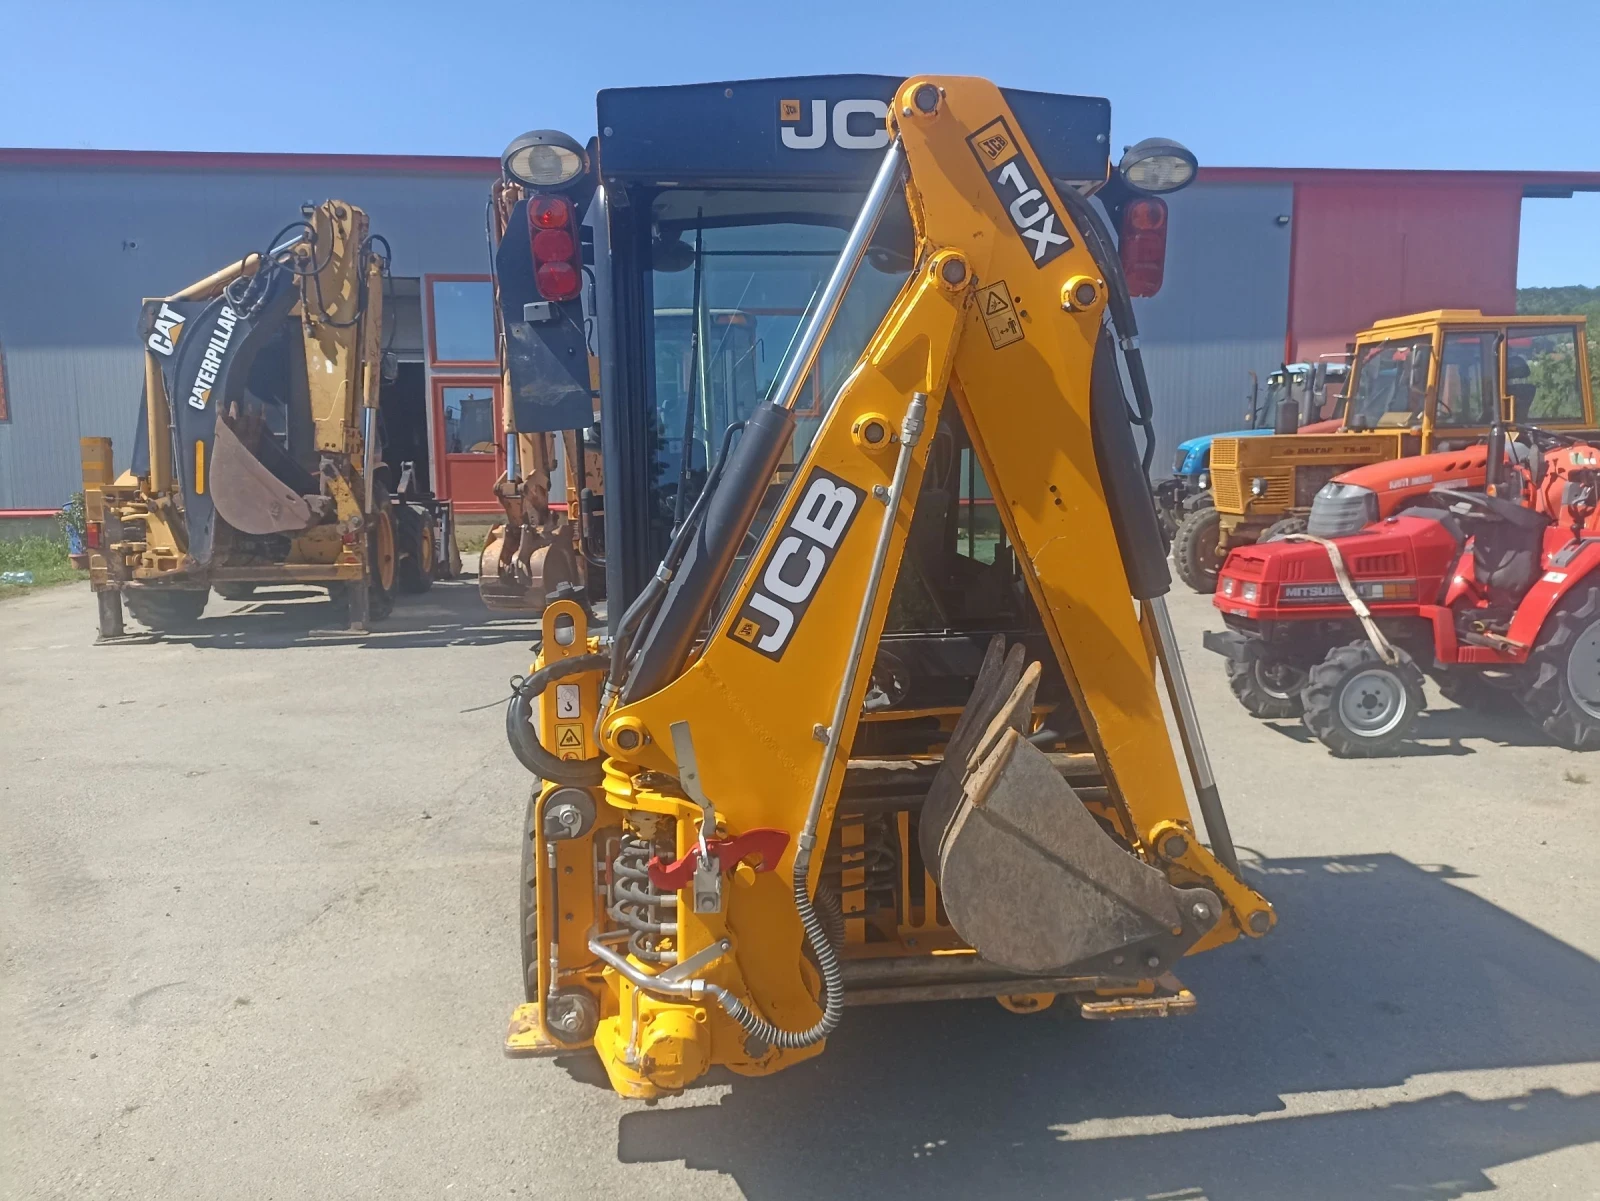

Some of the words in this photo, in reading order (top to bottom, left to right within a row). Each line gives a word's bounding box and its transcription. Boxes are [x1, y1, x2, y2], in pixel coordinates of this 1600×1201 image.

[780, 99, 890, 150] JC
[982, 136, 1006, 157] JCB
[997, 160, 1070, 261] 1CX
[148, 302, 186, 356] CAT
[188, 305, 238, 411] CATERPILLAR
[748, 477, 858, 653] JCB
